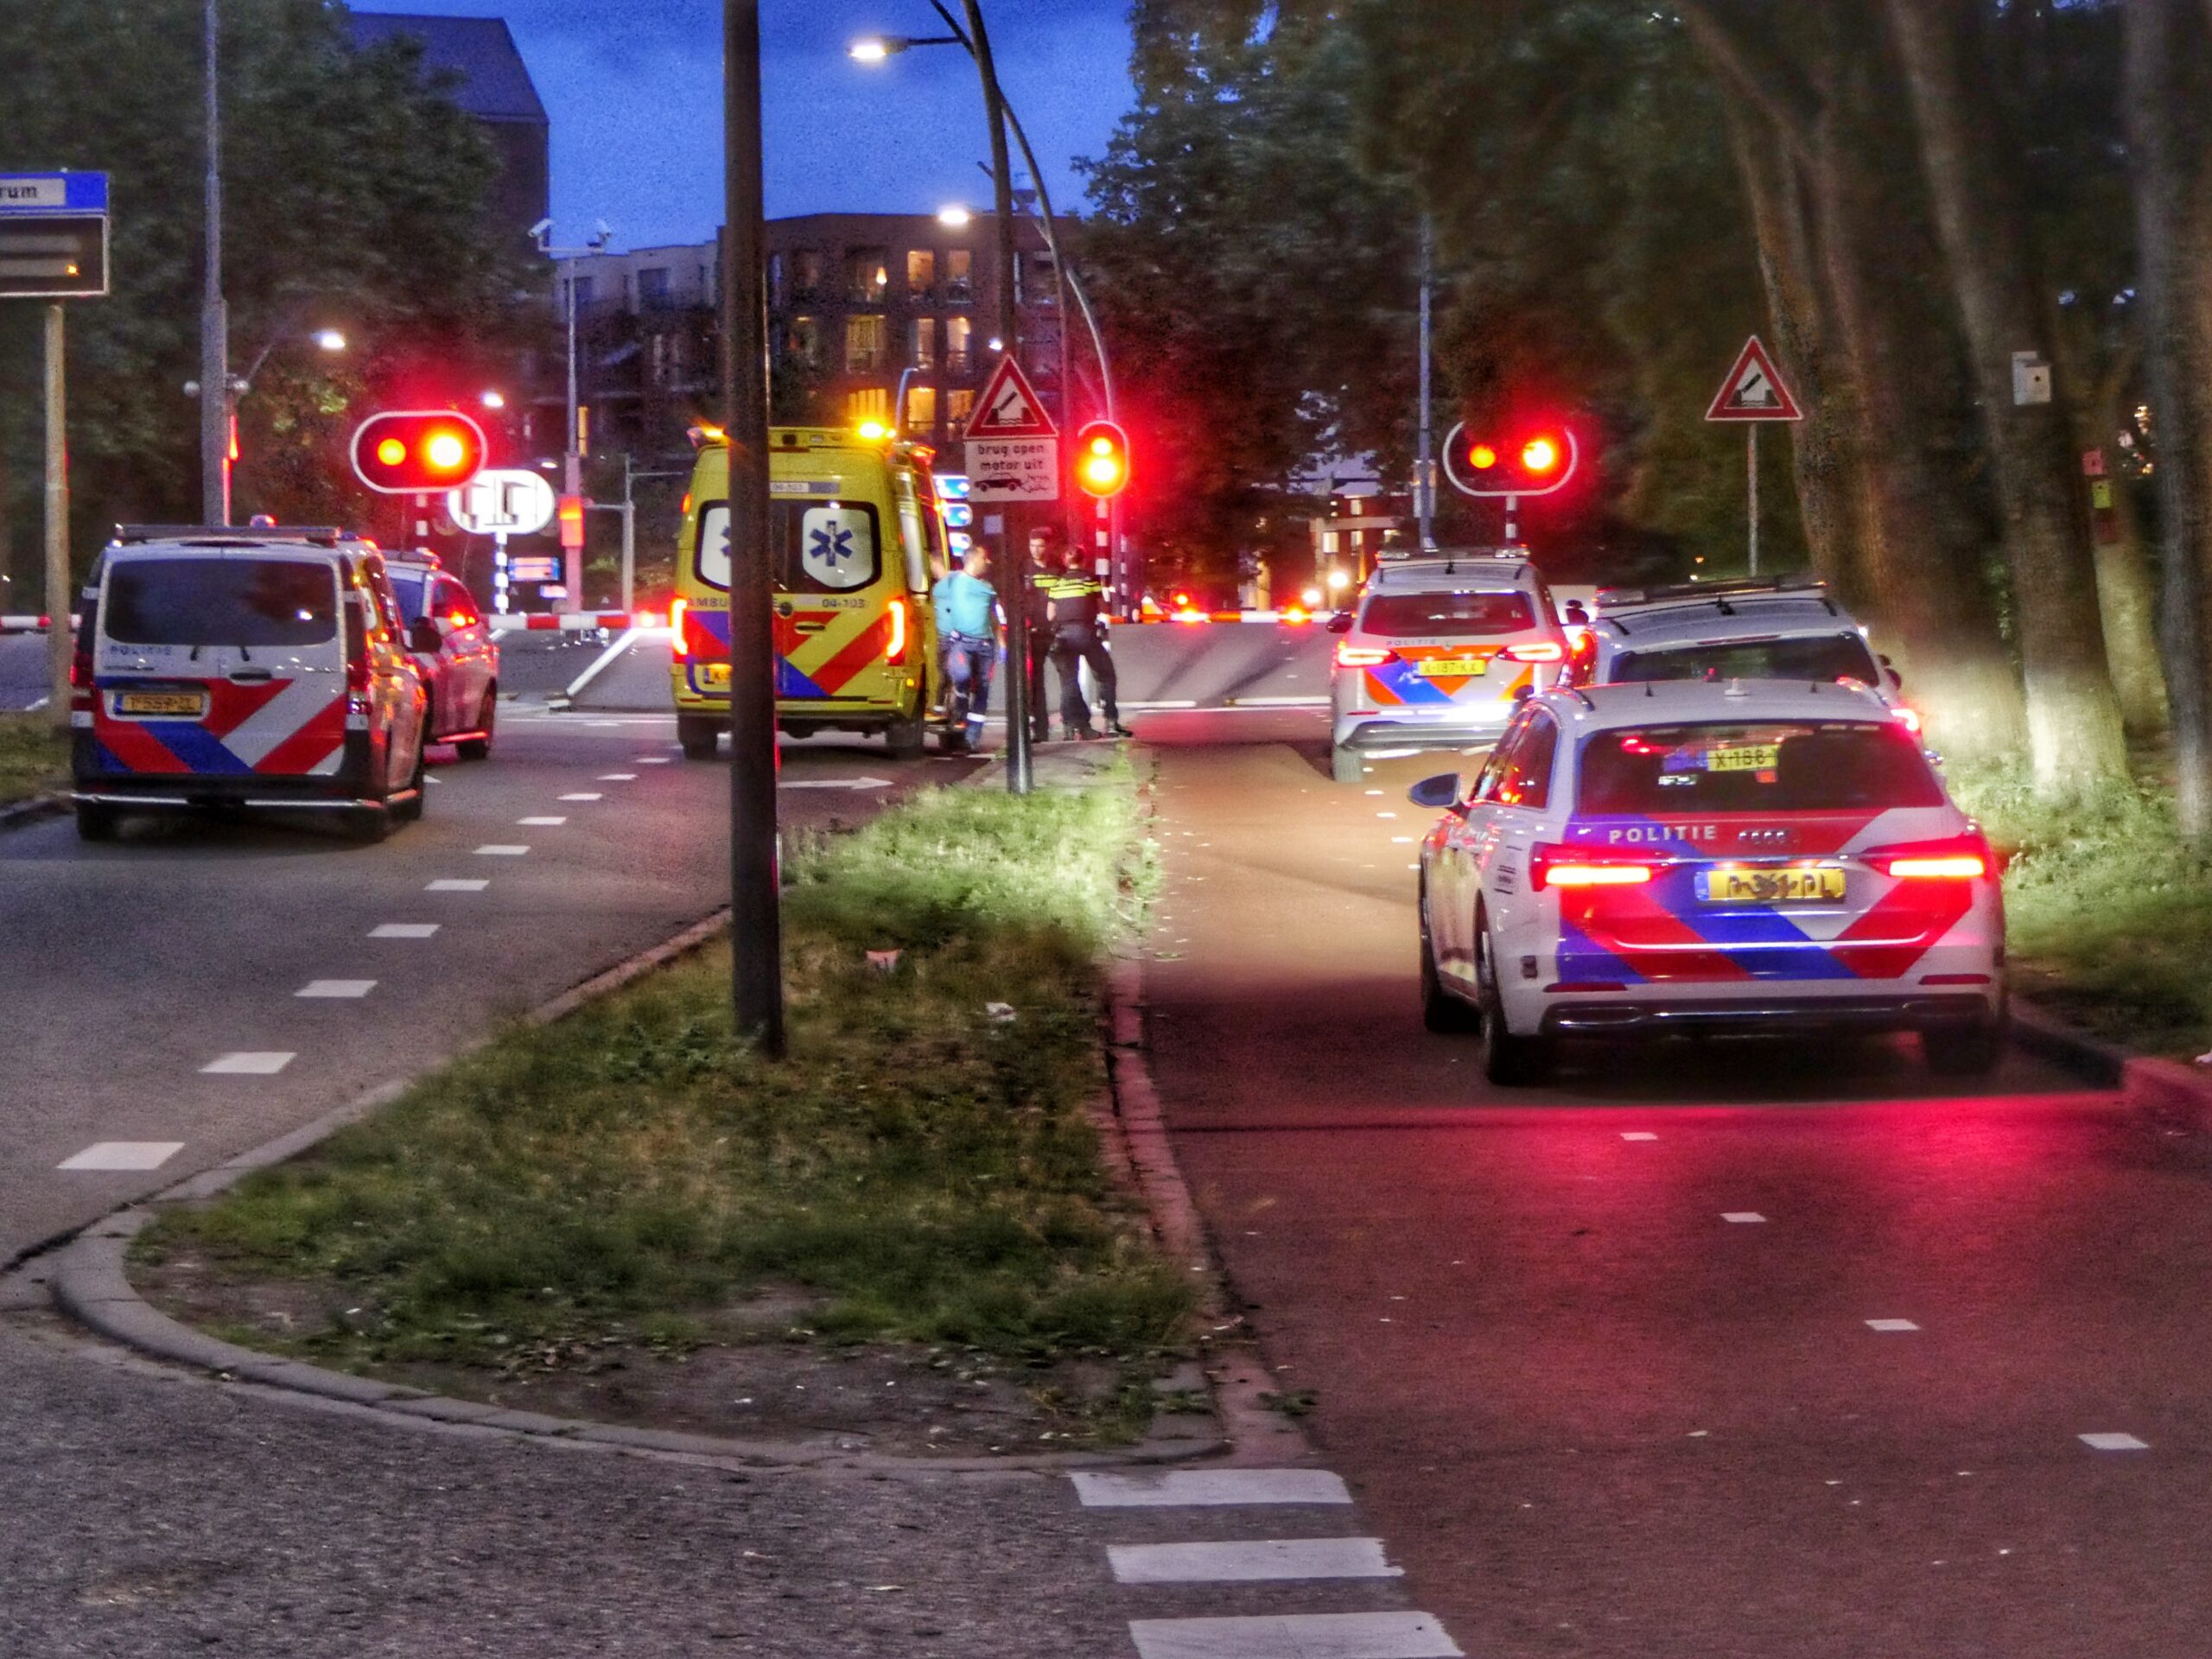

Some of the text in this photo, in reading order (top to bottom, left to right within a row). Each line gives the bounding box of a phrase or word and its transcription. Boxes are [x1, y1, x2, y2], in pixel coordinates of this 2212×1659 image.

[977, 444, 1044, 457] brug open
[980, 458, 1043, 470] motor uit
[1608, 825, 1717, 843] POLITIE
